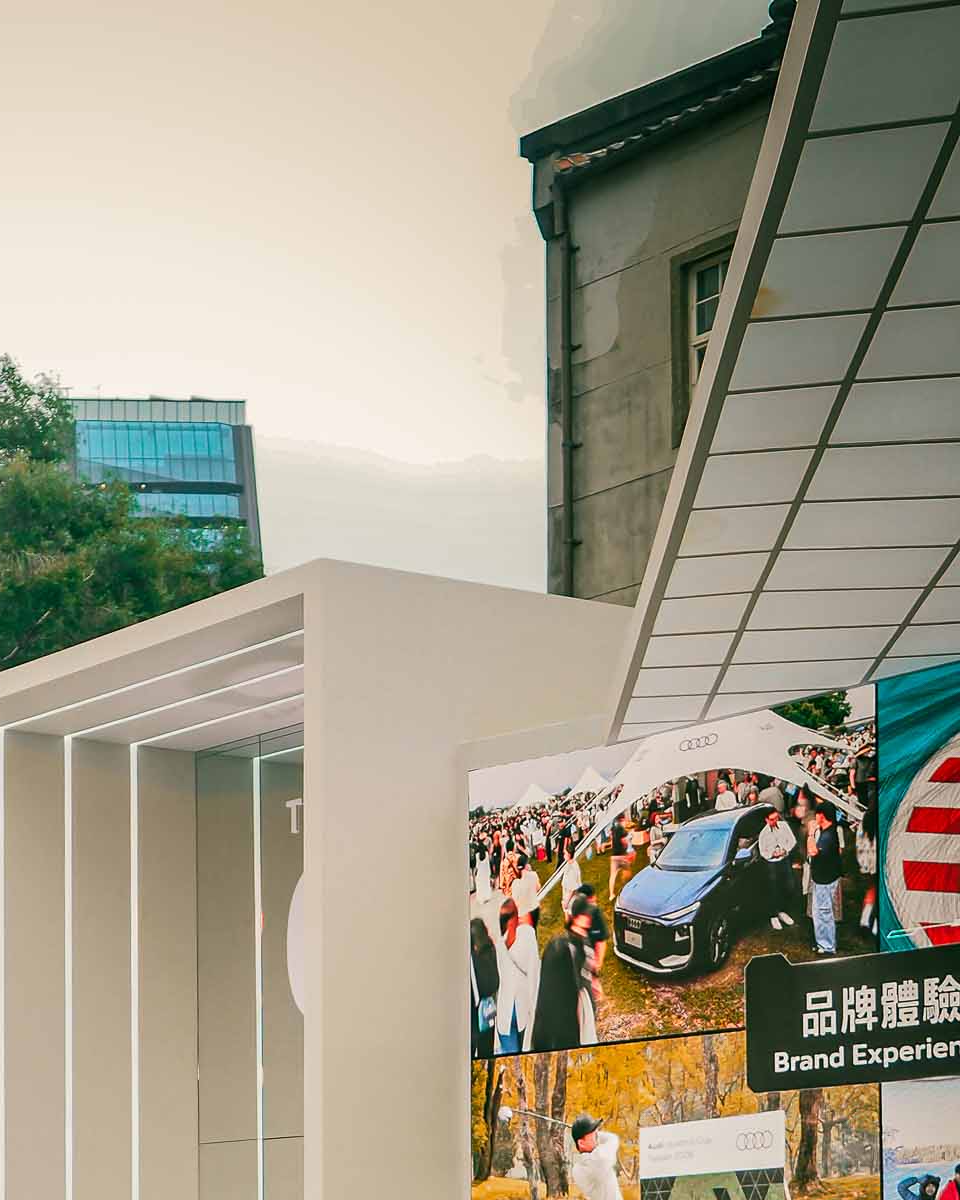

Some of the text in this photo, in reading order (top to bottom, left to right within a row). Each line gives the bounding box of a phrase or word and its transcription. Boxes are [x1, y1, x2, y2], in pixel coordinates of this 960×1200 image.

[802, 974, 960, 1038] 品牌體驗
[773, 1045, 845, 1073] Brand
